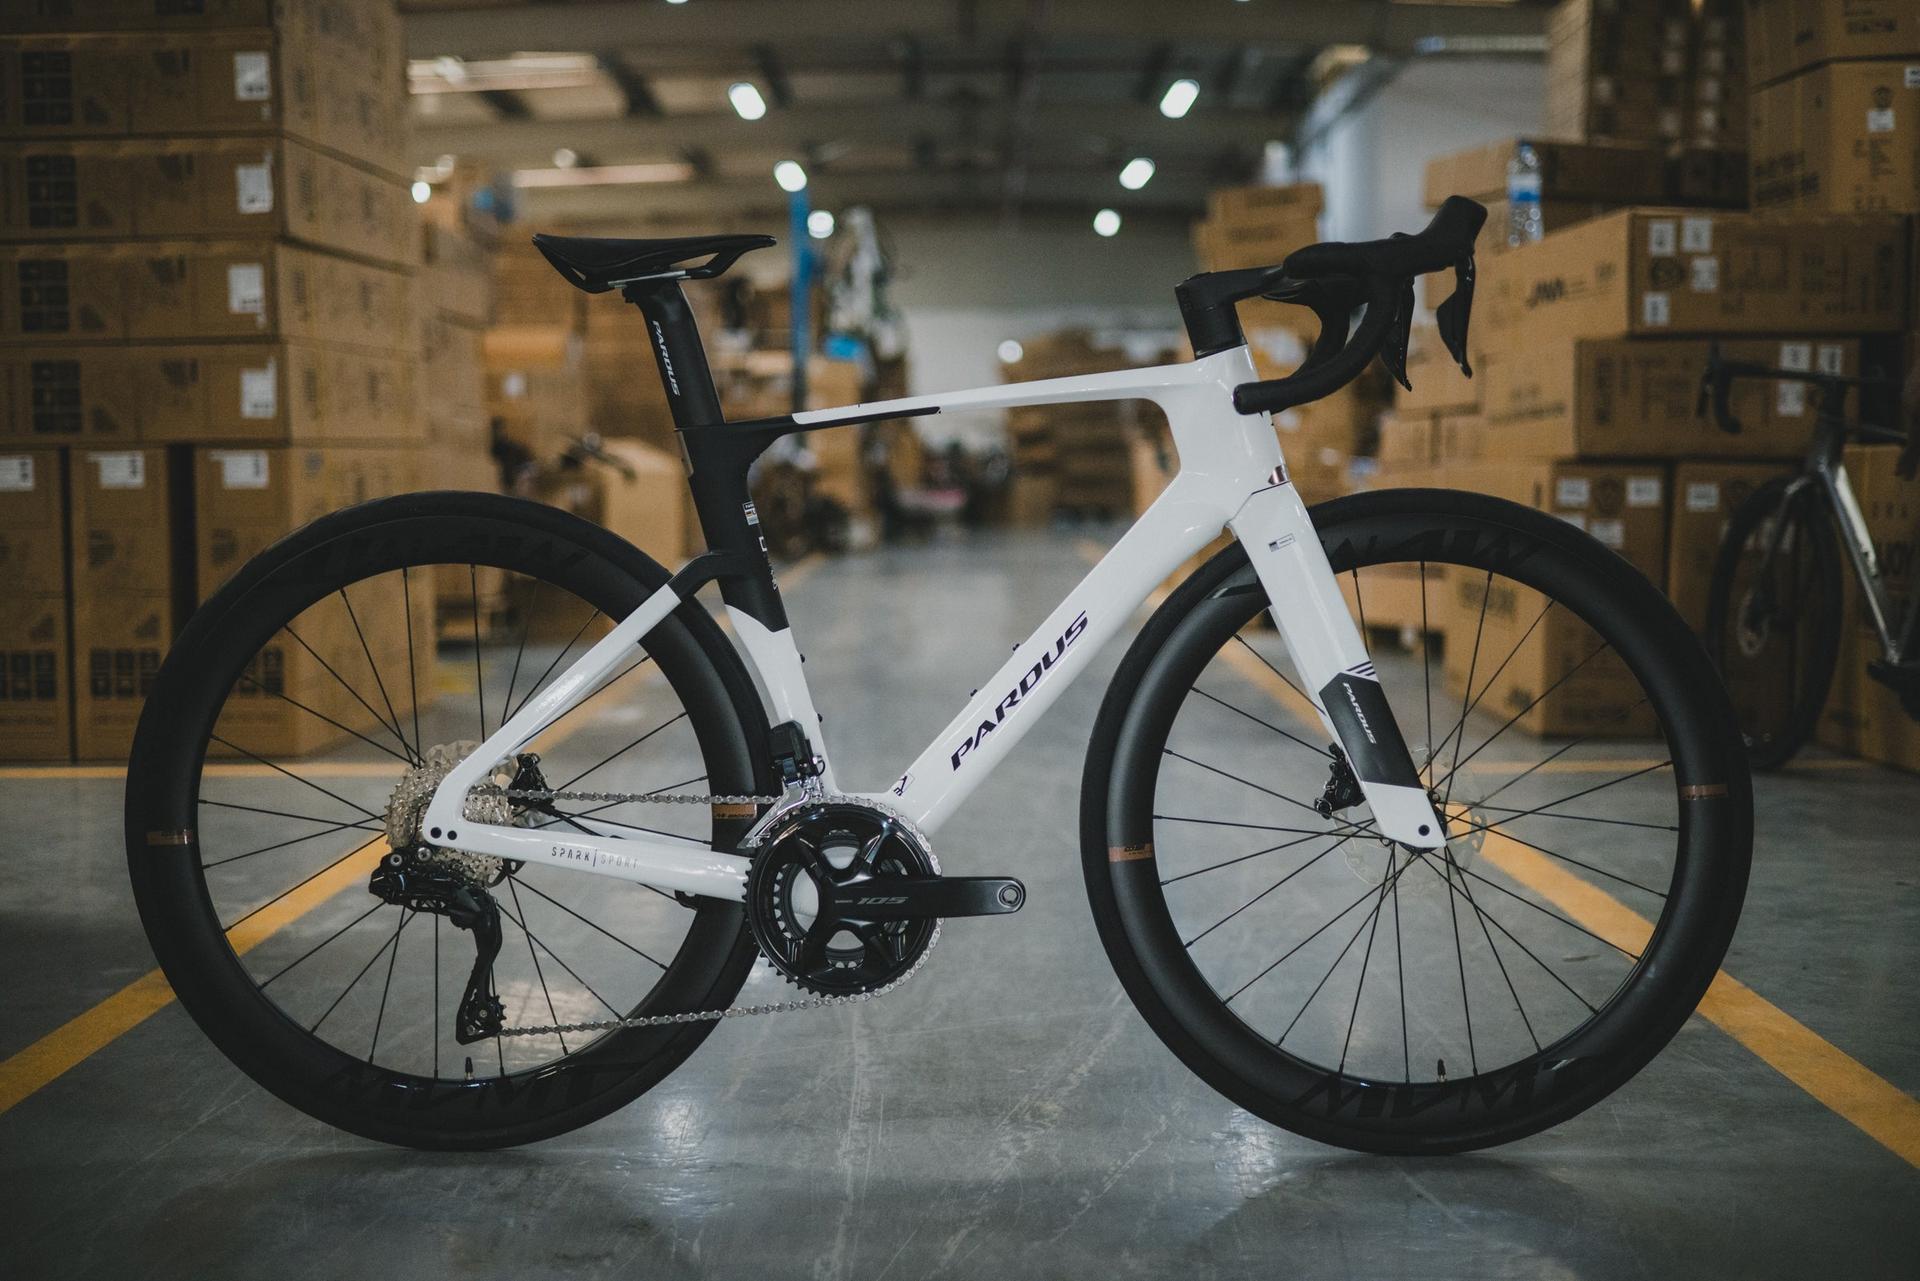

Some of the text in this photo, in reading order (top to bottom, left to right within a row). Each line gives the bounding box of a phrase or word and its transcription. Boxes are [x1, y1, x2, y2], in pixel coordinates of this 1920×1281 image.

[652, 320, 680, 396] PARDUS
[950, 610, 1088, 771] PARDUS
[1343, 682, 1377, 744] PARDUS
[857, 896, 909, 905] 105
